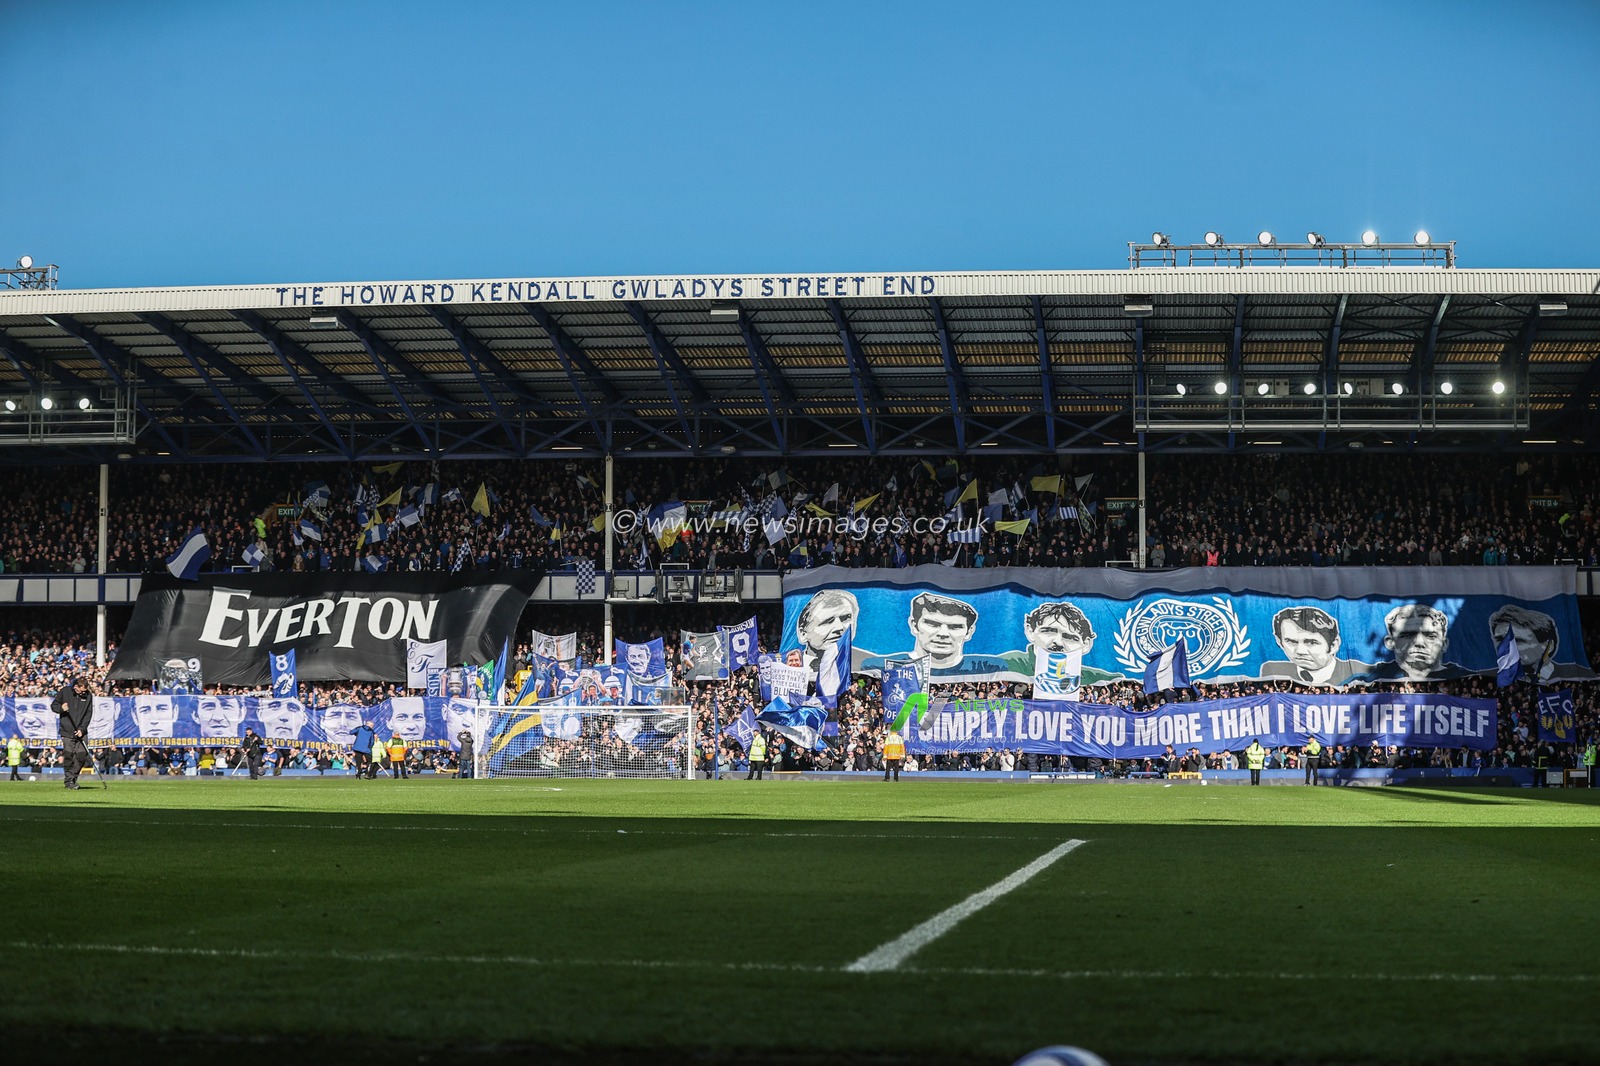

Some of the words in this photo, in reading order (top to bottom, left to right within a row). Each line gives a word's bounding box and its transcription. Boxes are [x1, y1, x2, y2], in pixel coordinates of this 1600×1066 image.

[276, 286, 324, 305] THE
[341, 283, 455, 304] HOWARD
[471, 281, 595, 301] KENDALL
[611, 278, 743, 299] GWLADYS
[761, 277, 865, 297] STREET
[882, 275, 936, 295] END
[198, 586, 440, 648] EVERTON
[1137, 603, 1184, 637] GWLADYS
[1187, 606, 1226, 632] STREET
[732, 632, 750, 665] 9
[188, 658, 200, 672] 9
[276, 654, 288, 672] 8
[896, 670, 914, 680] THE
[1538, 694, 1573, 714] EFC
[884, 708, 897, 720] TOF
[918, 709, 1008, 742] SIMPLY
[1014, 710, 1072, 742] LOVE
[1081, 713, 1126, 746] YOU
[1134, 712, 1204, 746] MORE
[1208, 704, 1270, 740] THAN
[1278, 704, 1286, 734] I
[1293, 704, 1350, 734] LOVE
[1360, 704, 1406, 734] LIFE
[1414, 704, 1489, 738] ITSELF
[87, 738, 112, 748] REATS
[134, 738, 160, 746] PASSED
[162, 738, 198, 746] THROUGH
[200, 738, 242, 746] GOODISON'
[276, 739, 285, 748] TO
[287, 740, 304, 748] PLAY
[407, 740, 436, 748] CIENCE
